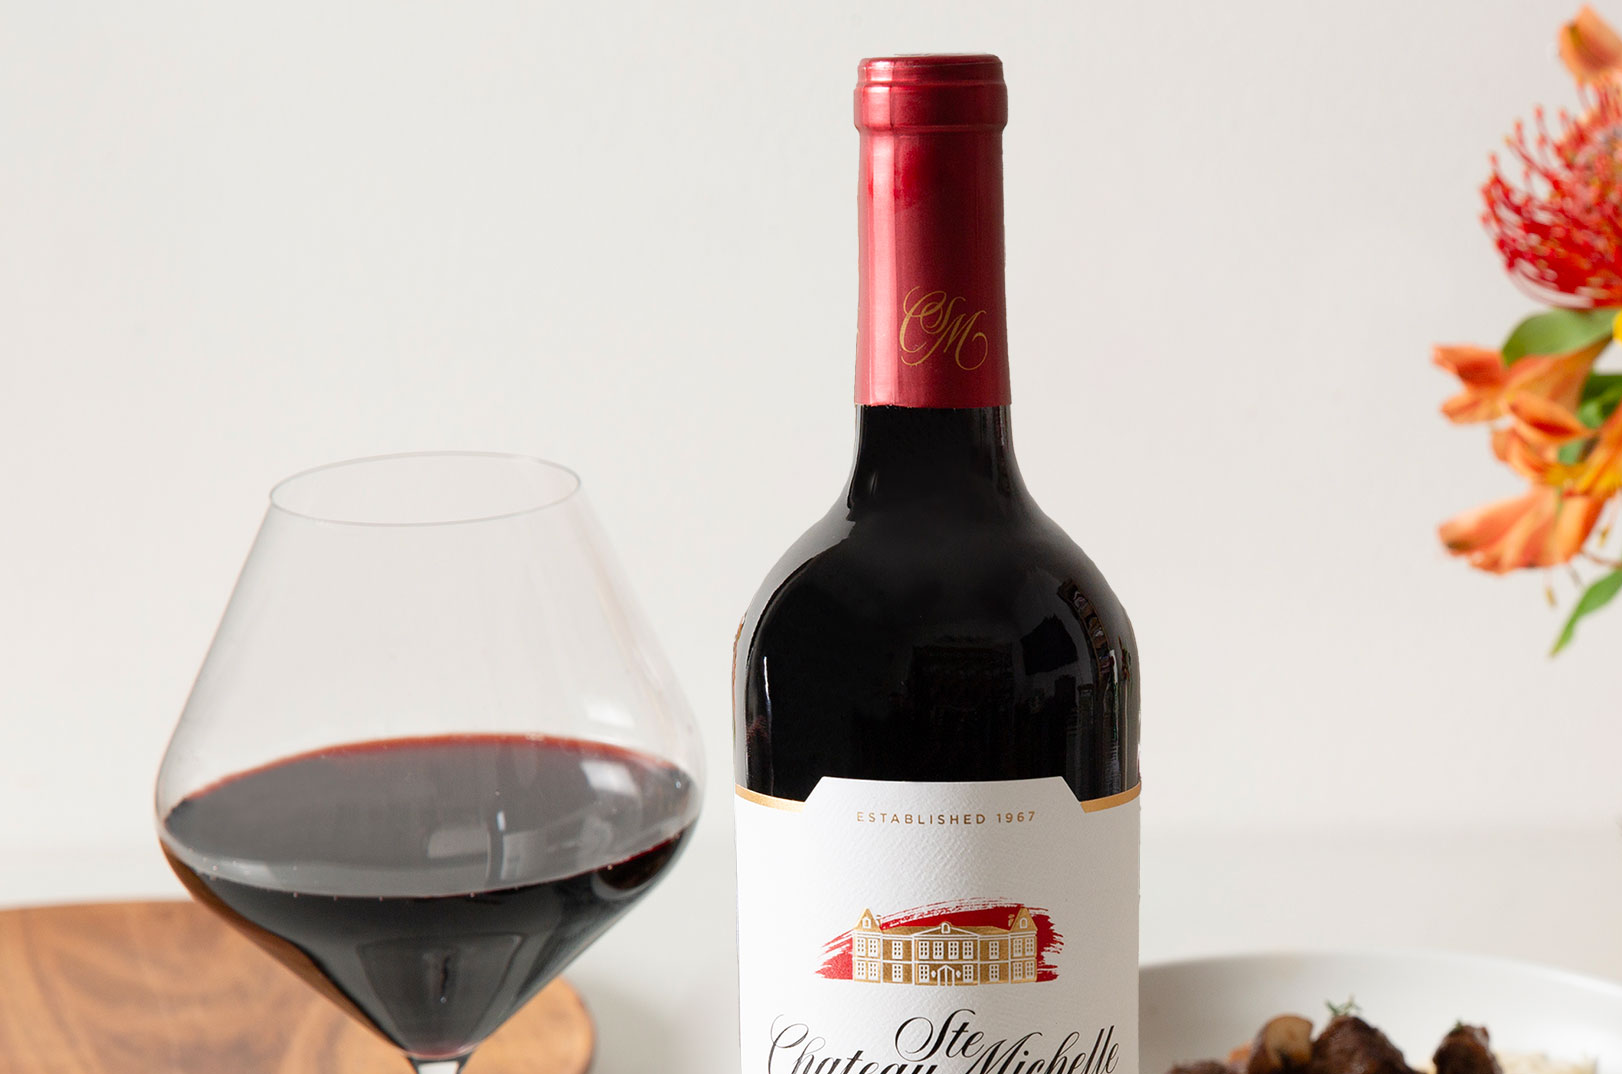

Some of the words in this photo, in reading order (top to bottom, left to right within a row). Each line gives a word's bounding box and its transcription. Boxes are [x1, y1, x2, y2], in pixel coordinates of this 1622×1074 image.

[856, 810, 987, 825] ESTABLISHED
[996, 810, 1037, 824] 1967
[894, 1008, 985, 1063] Ste
